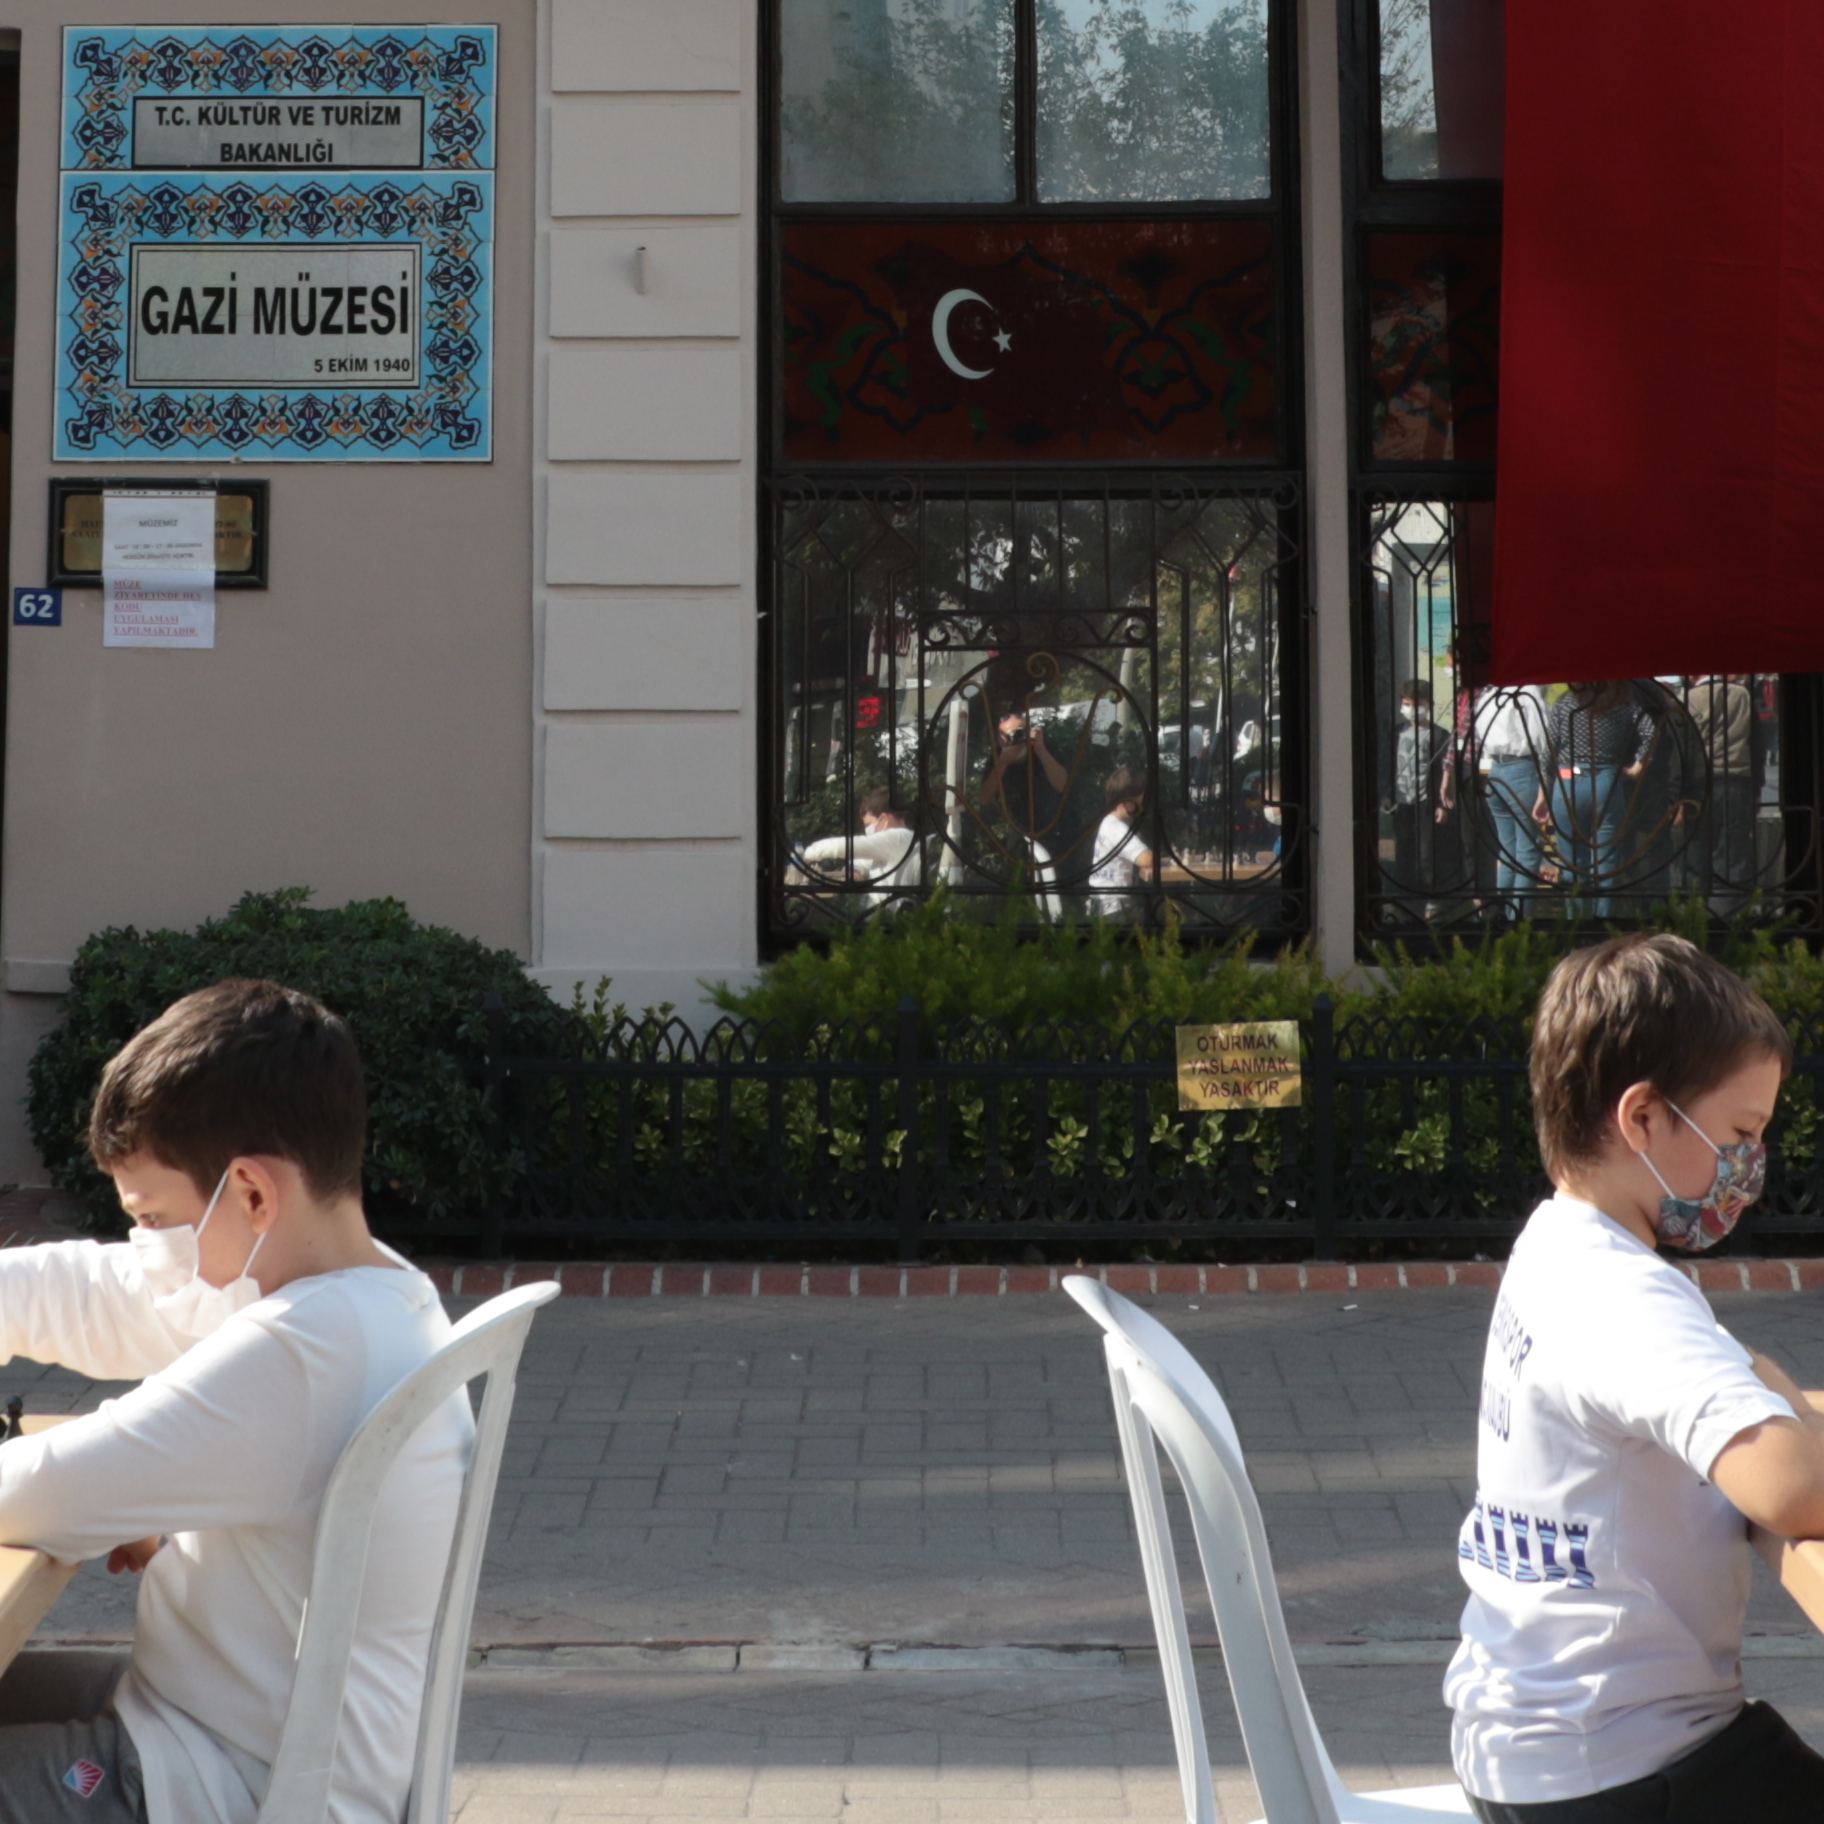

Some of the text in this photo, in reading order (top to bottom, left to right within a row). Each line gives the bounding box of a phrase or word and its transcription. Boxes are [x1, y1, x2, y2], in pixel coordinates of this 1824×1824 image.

[155, 101, 401, 126] T.C. KÜLTÜR VE TURİZM
[220, 138, 334, 163] BAKANLIĞI
[141, 271, 409, 336] GAZİ MÜZESİ
[314, 354, 411, 373] 5 EKİM 1940
[138, 519, 179, 528] MÜZEMİZ
[113, 579, 142, 589] MÜZE
[113, 589, 179, 600] ZİYARETİNDE
[19, 594, 53, 618] 62
[113, 603, 142, 612] KODU
[113, 615, 179, 624] UYGULAMASI
[1197, 1034, 1278, 1052] OTURMAK
[1188, 1057, 1289, 1076] YASLANMAK
[1200, 1080, 1280, 1098] YASAKTIR
